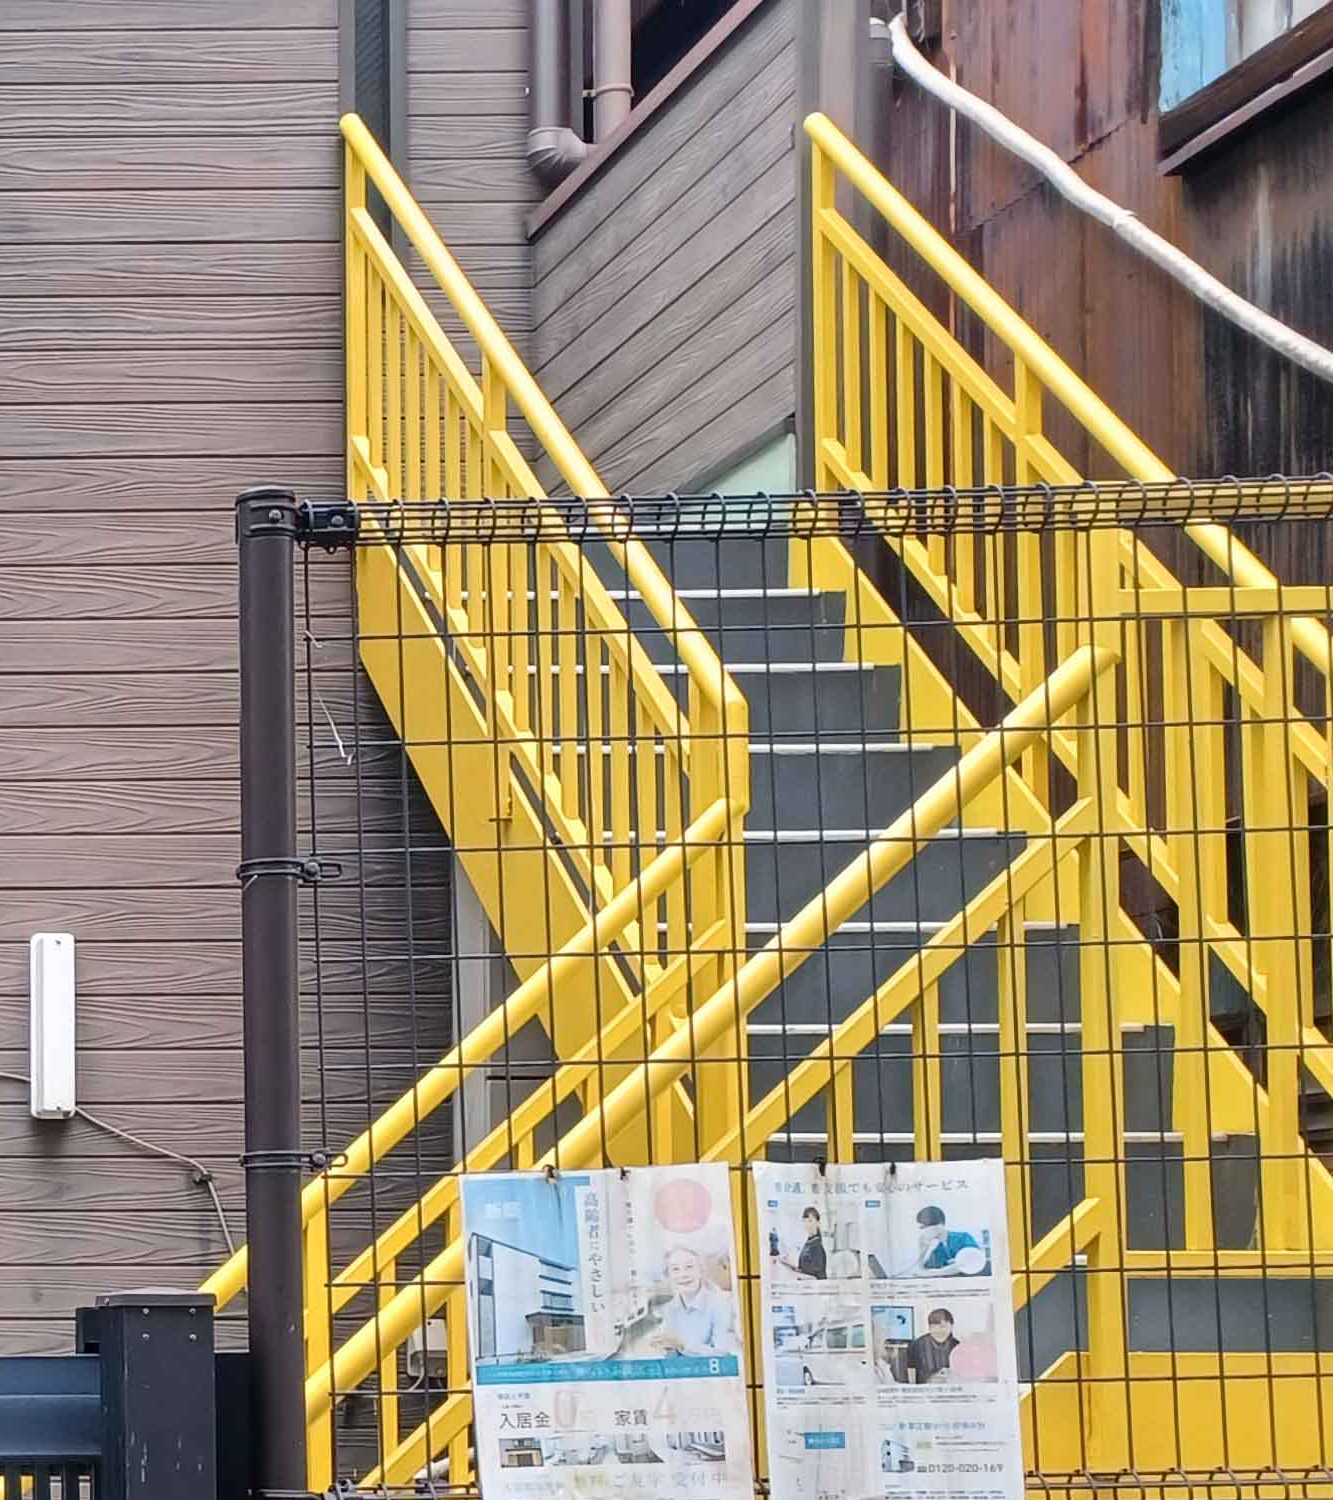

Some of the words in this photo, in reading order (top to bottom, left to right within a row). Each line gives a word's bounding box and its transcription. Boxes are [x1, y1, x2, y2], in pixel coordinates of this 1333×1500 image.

[499, 1411, 552, 1430] 入居金
[614, 1408, 649, 1427] 家賃
[928, 1463, 1004, 1474] 0120-020-169
